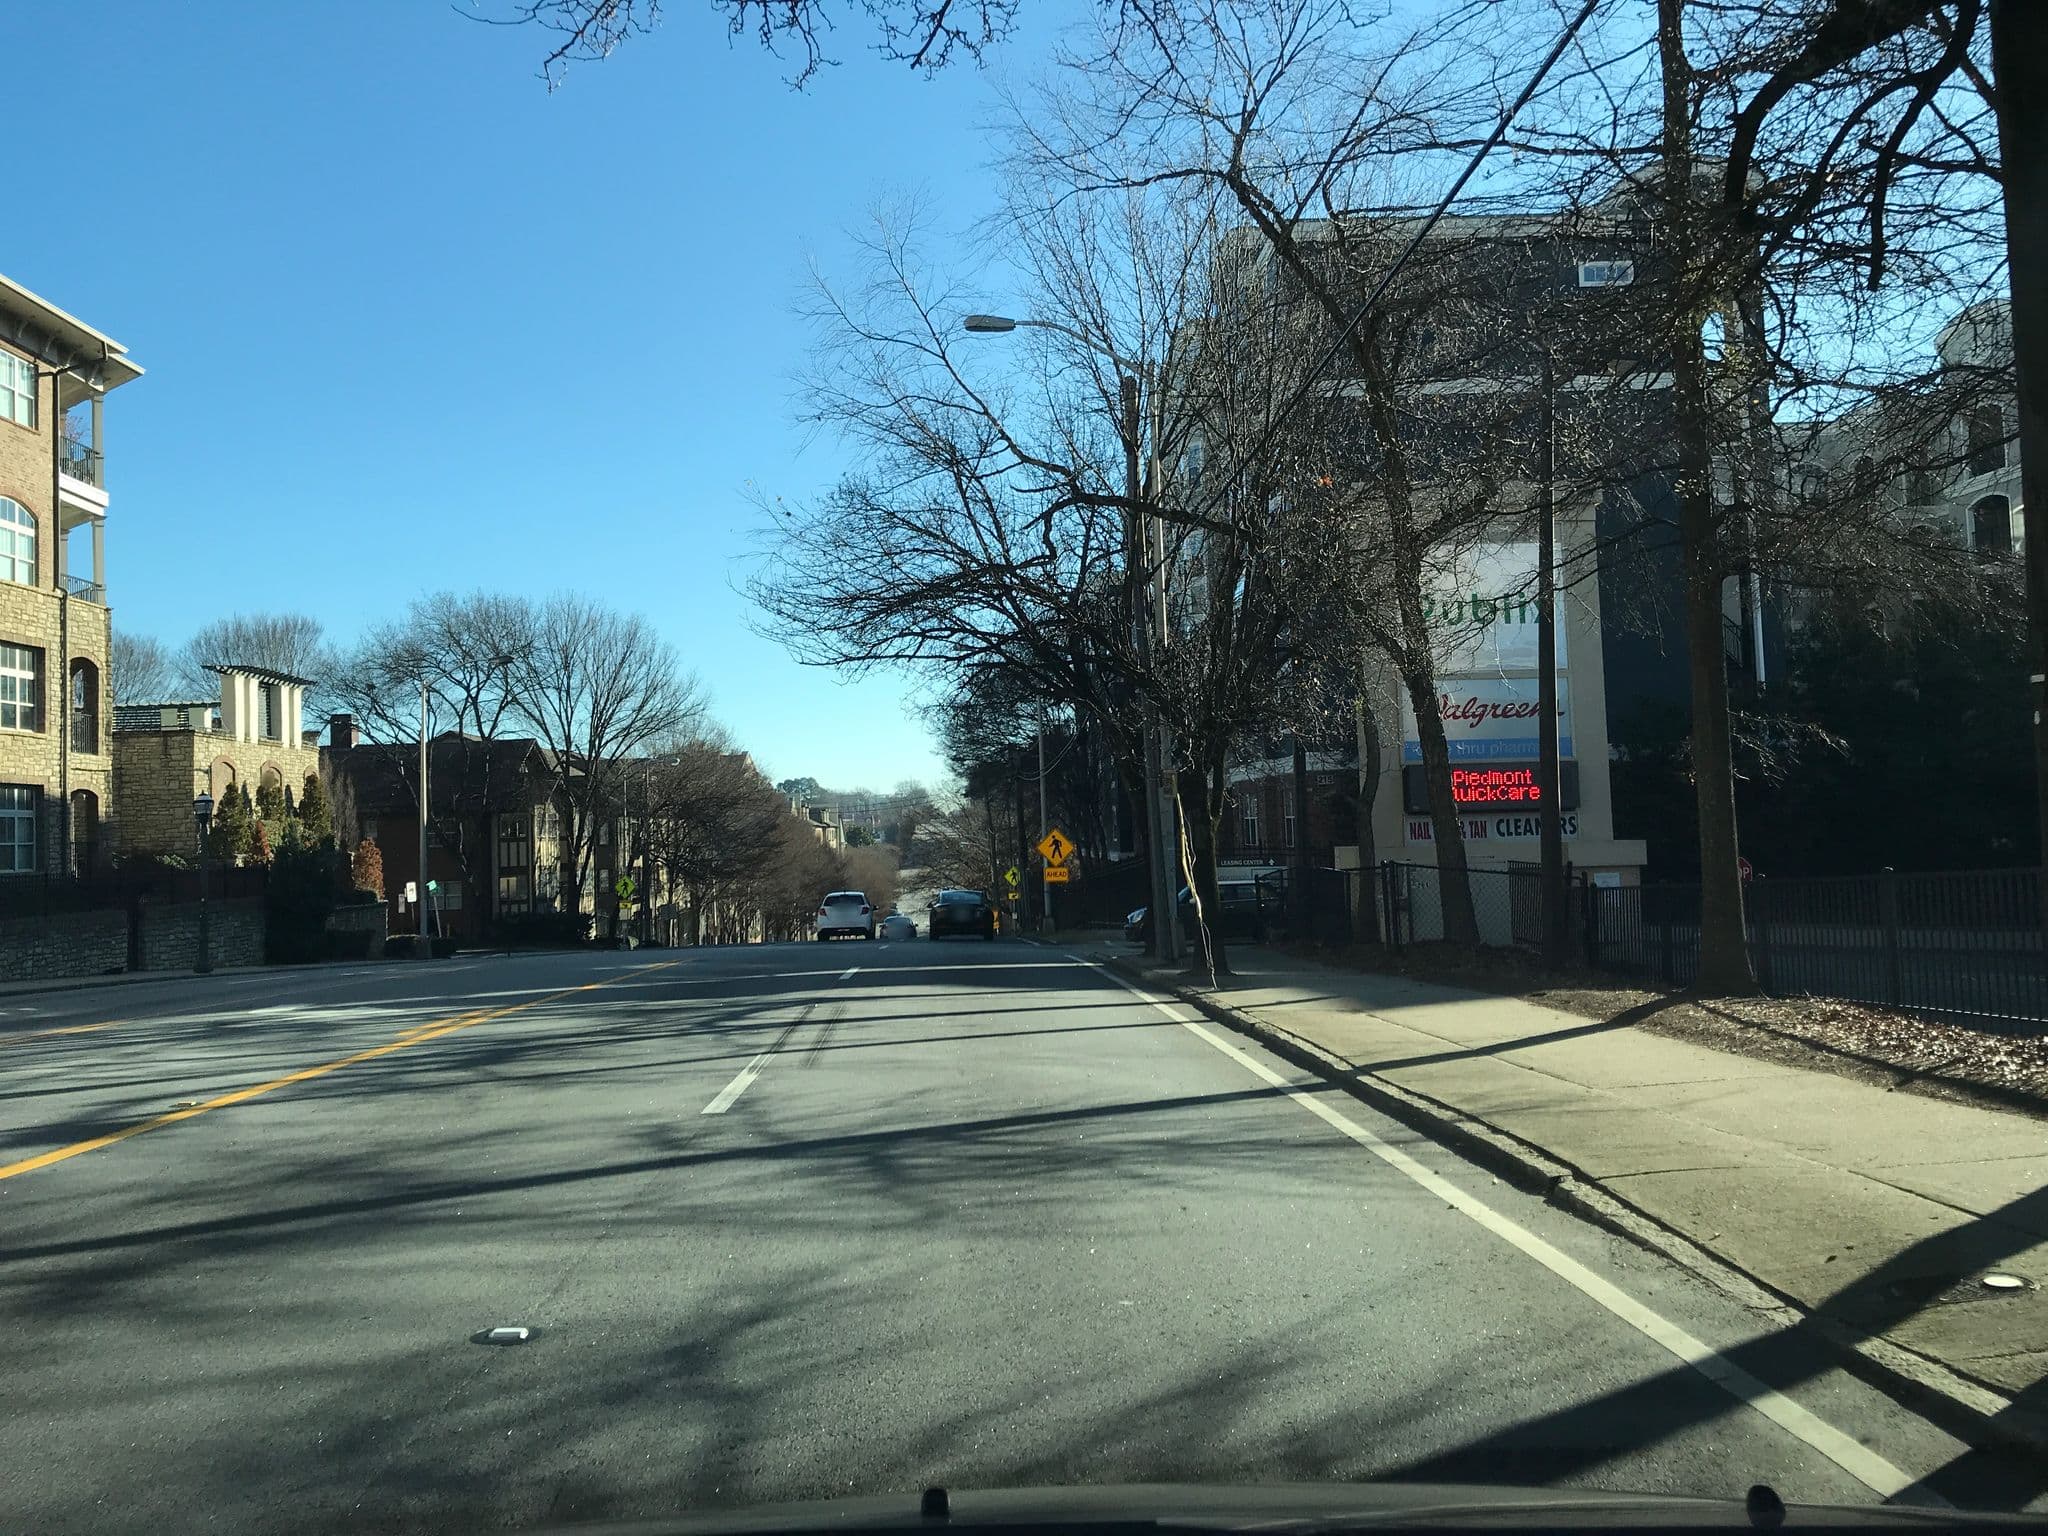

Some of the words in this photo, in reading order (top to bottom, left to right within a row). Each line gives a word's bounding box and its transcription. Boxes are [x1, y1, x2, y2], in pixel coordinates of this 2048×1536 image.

[1441, 694, 1565, 728] algree
[1453, 769, 1532, 785] Piedmont
[1469, 820, 1487, 838] TAN
[1496, 816, 1577, 837] CLEANRS
